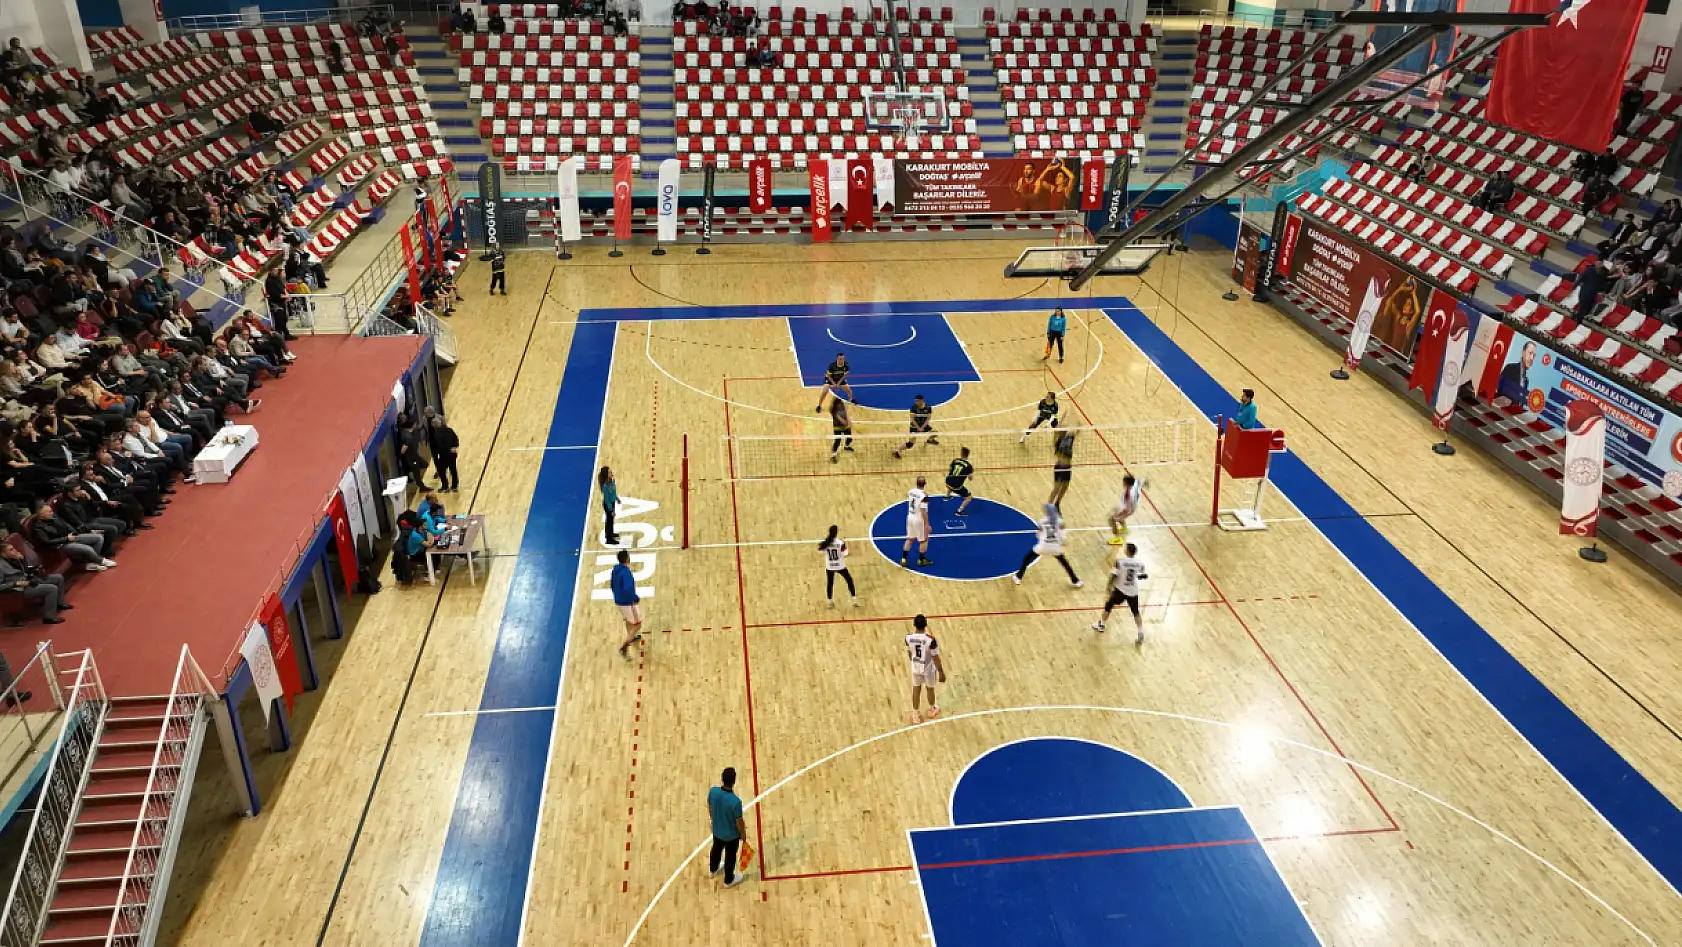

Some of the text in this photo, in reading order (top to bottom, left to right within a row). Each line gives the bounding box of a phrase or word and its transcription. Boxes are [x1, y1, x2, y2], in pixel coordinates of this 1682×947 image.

[905, 161, 990, 172] KARAKURT MOBİLYA
[919, 172, 949, 182] DOĞTAŞ
[812, 173, 828, 216] arçelik
[913, 190, 987, 200] BAŞARILAR DİLERİZ.
[1560, 363, 1656, 421] MÜSABAKALARA KATILAN TÜM
[1598, 401, 1651, 437] ANTRENÖRLERE
[591, 496, 675, 600] AĞRI
[826, 548, 839, 561] 10
[915, 644, 922, 658] 6
